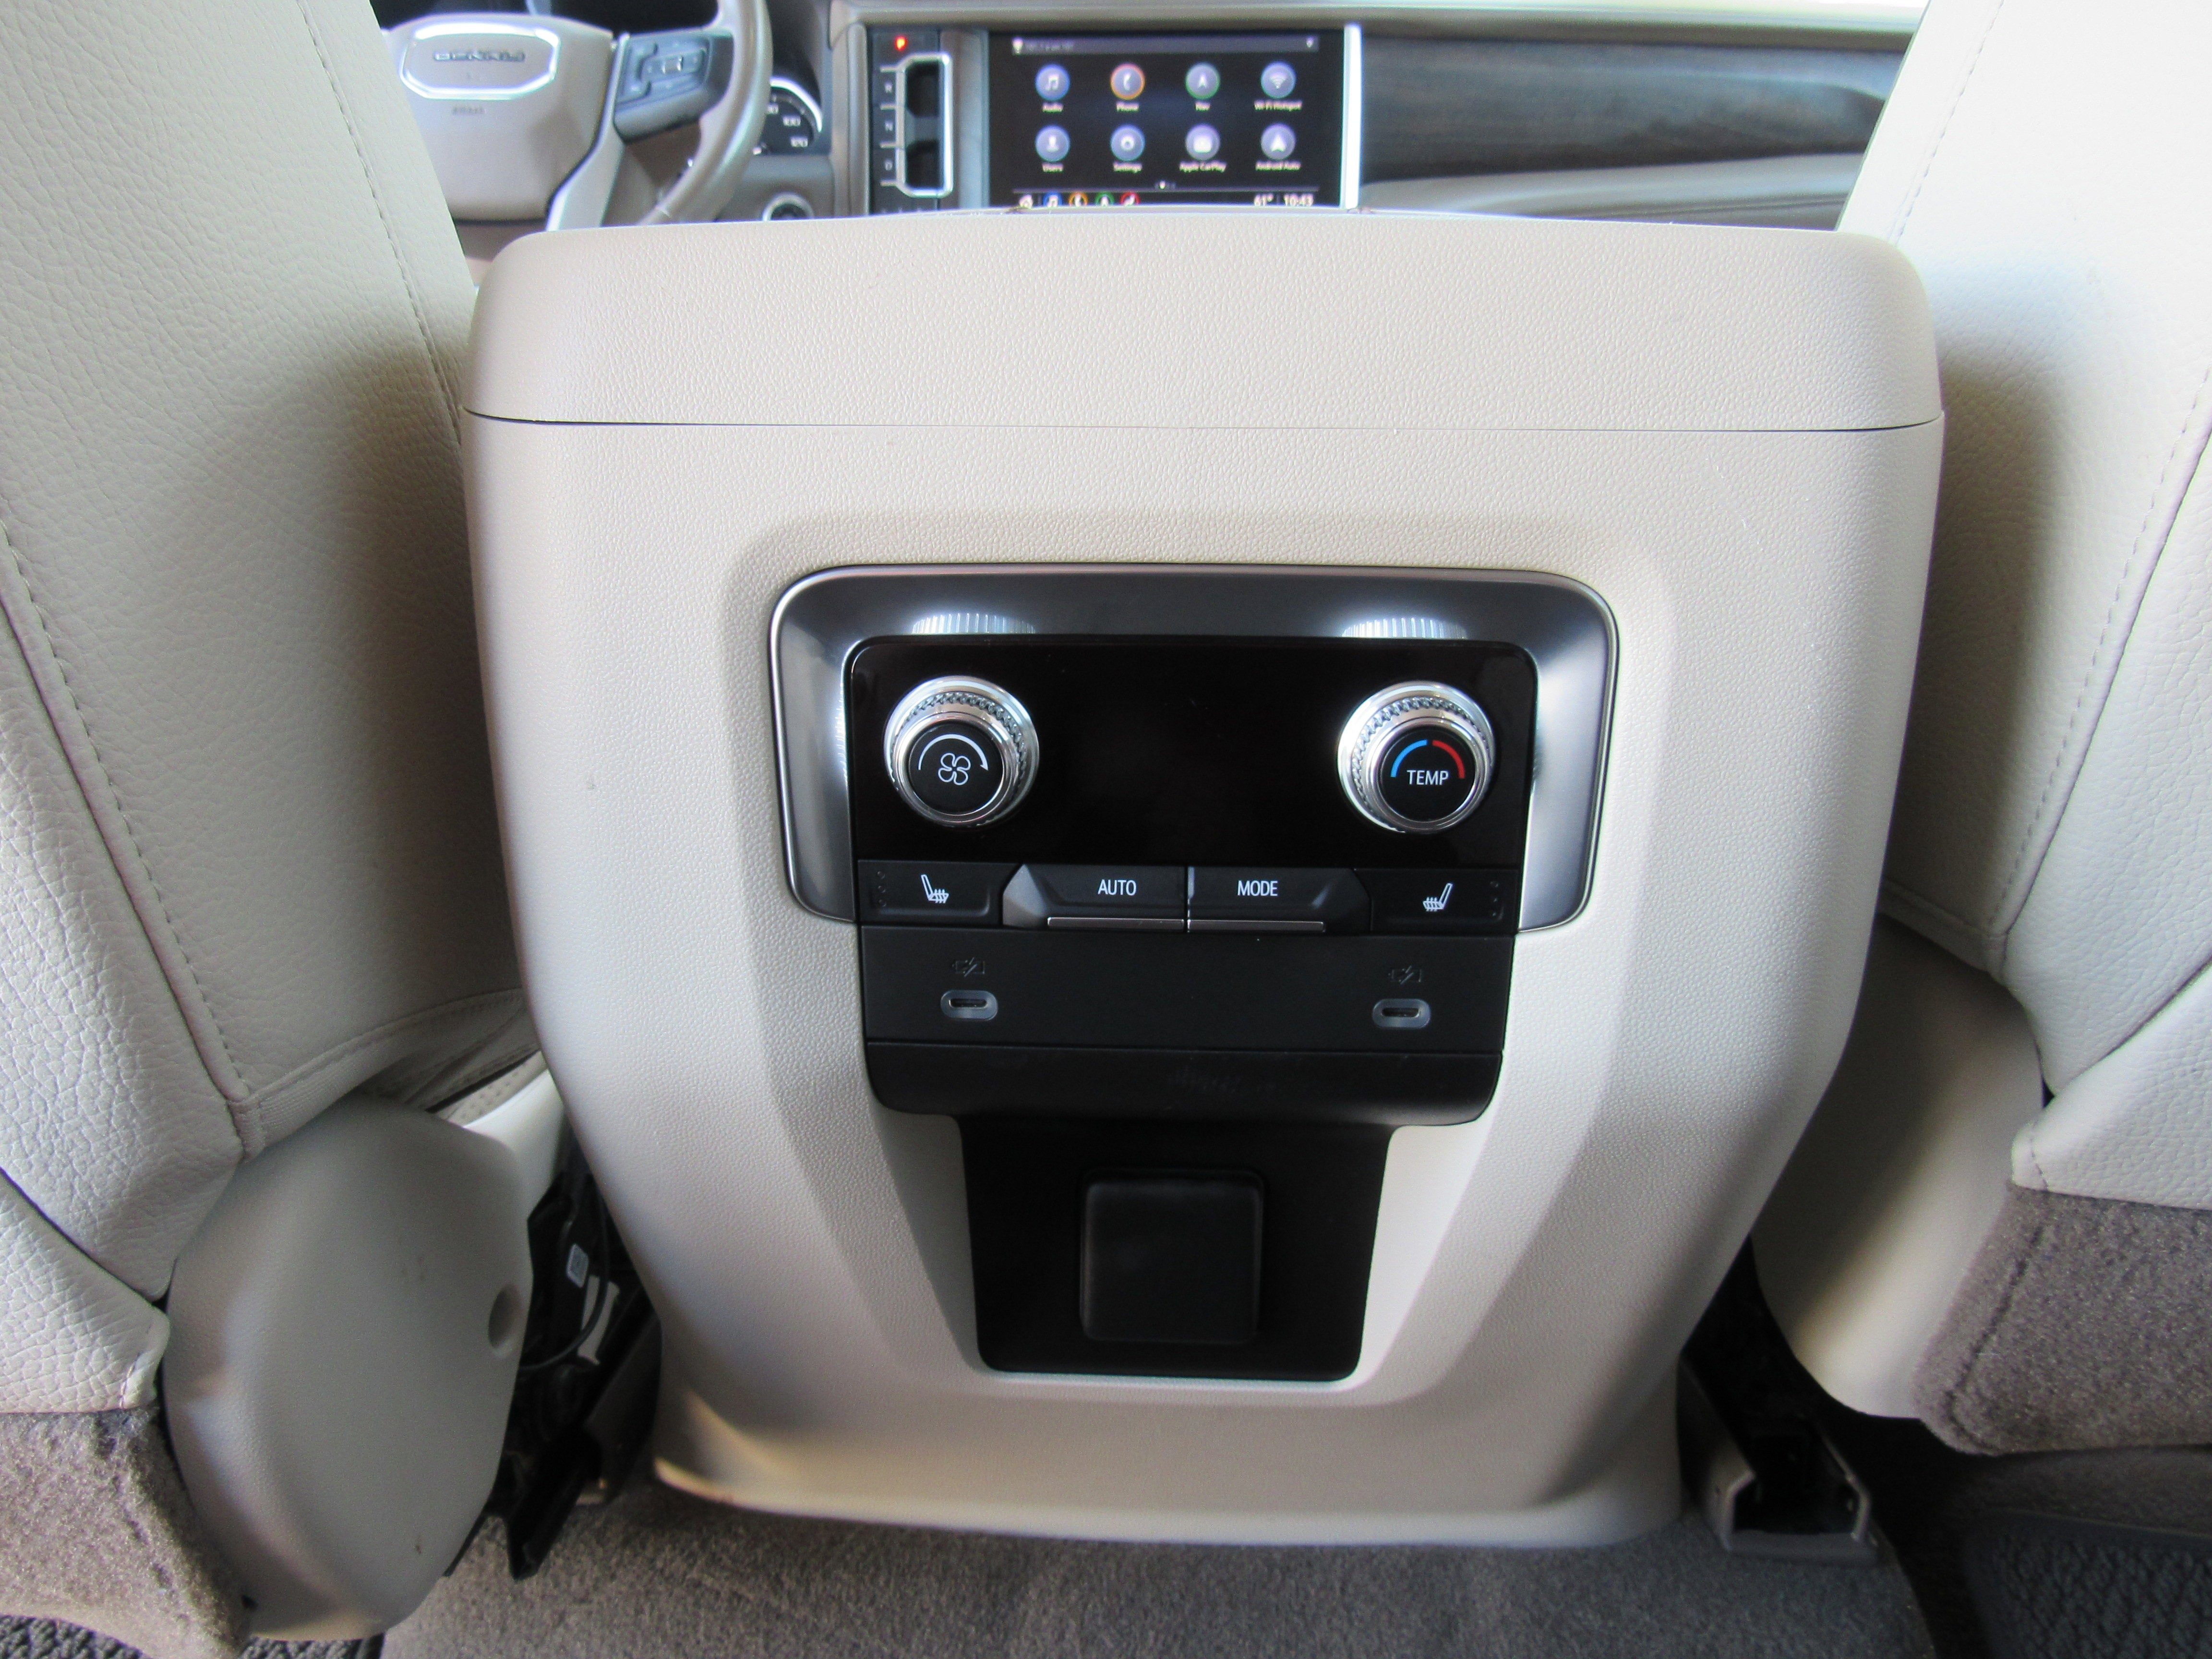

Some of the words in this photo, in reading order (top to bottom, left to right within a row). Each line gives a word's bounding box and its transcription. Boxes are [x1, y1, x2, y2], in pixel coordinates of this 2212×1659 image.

[1407, 769, 1449, 786] TEMP
[1097, 879, 1137, 896] AUTO
[1237, 880, 1278, 896] MODE
